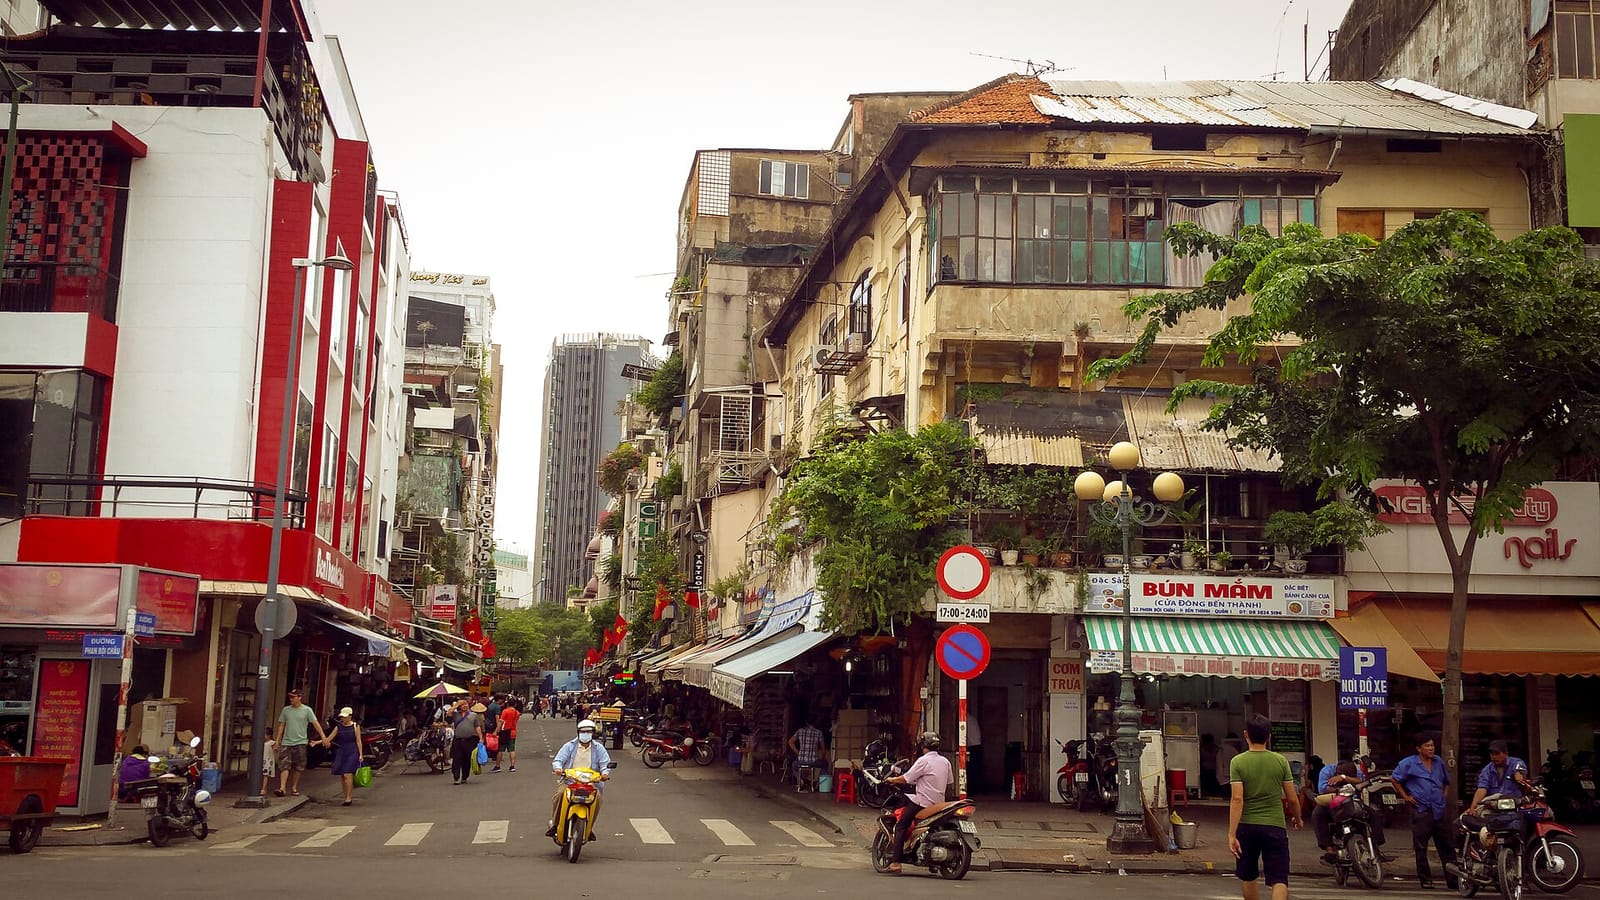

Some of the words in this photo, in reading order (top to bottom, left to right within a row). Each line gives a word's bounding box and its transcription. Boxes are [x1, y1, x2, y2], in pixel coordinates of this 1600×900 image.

[480, 496, 492, 562] HOTEL
[1504, 528, 1578, 568] nails
[695, 554, 703, 586] TATTOO
[1143, 580, 1194, 598] BÚN
[1204, 578, 1273, 600] MẮM
[84, 647, 98, 655] PHAN
[1053, 662, 1080, 674] CƠM
[1241, 658, 1269, 675] BÁNH
[1271, 662, 1299, 677] CANH
[1301, 663, 1321, 678] CUA
[1354, 651, 1376, 675] P
[1051, 677, 1081, 690] TRƯA
[1374, 680, 1387, 693] XE
